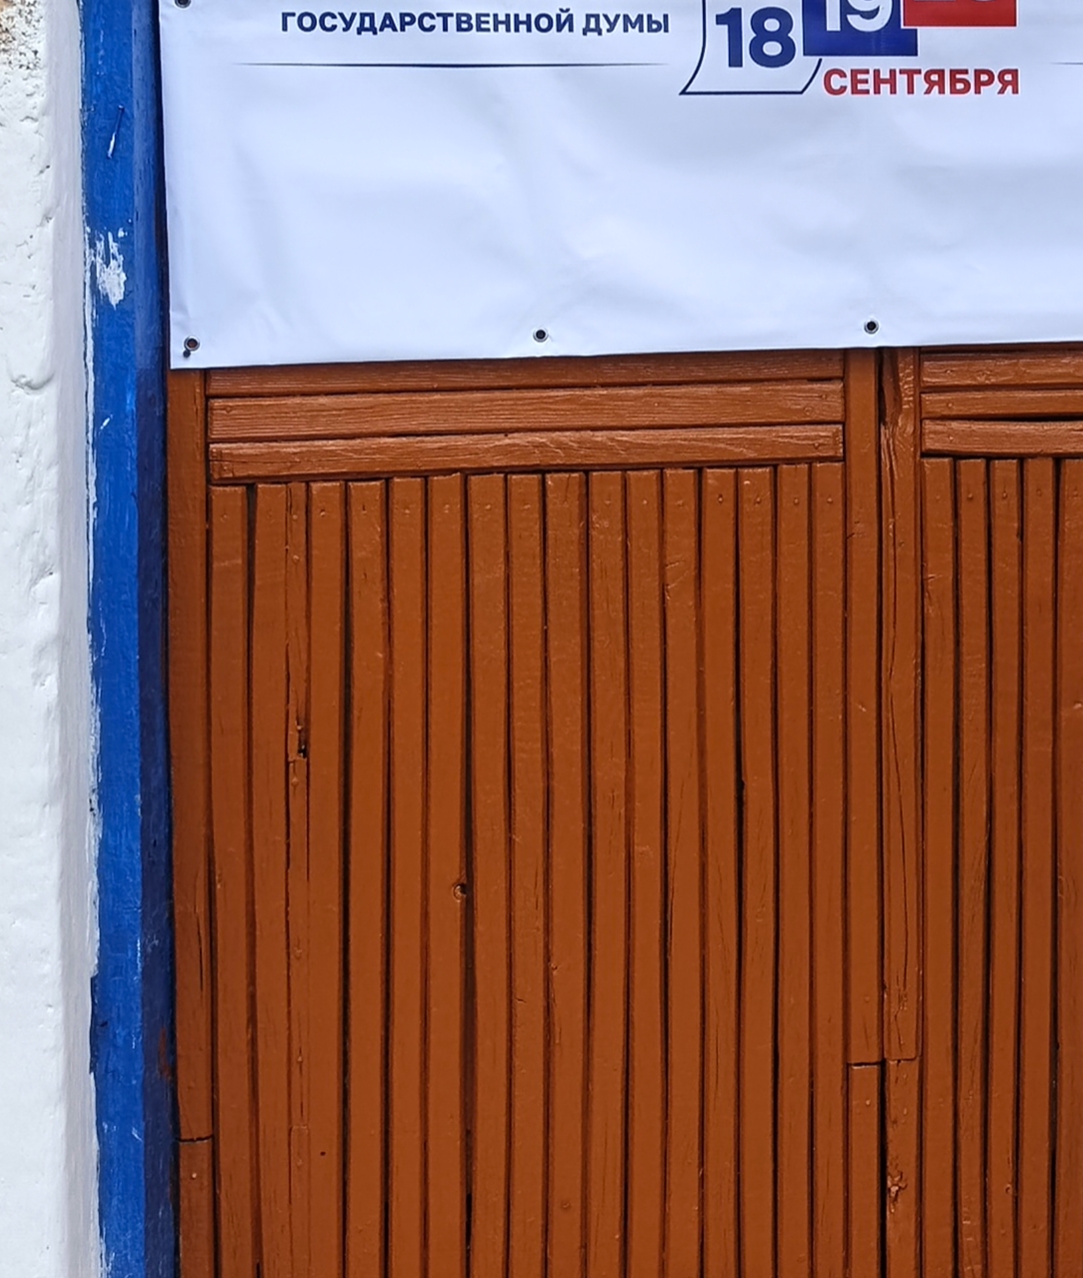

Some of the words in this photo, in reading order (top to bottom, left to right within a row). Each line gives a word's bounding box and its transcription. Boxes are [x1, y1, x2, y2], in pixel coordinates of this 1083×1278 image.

[281, 8, 574, 35] ГОСУДАРСТВЕННОЙ
[582, 13, 670, 36] ДУМЫ
[715, 6, 797, 69] 18
[823, 68, 1020, 96] СЕНТЯБРЯ
